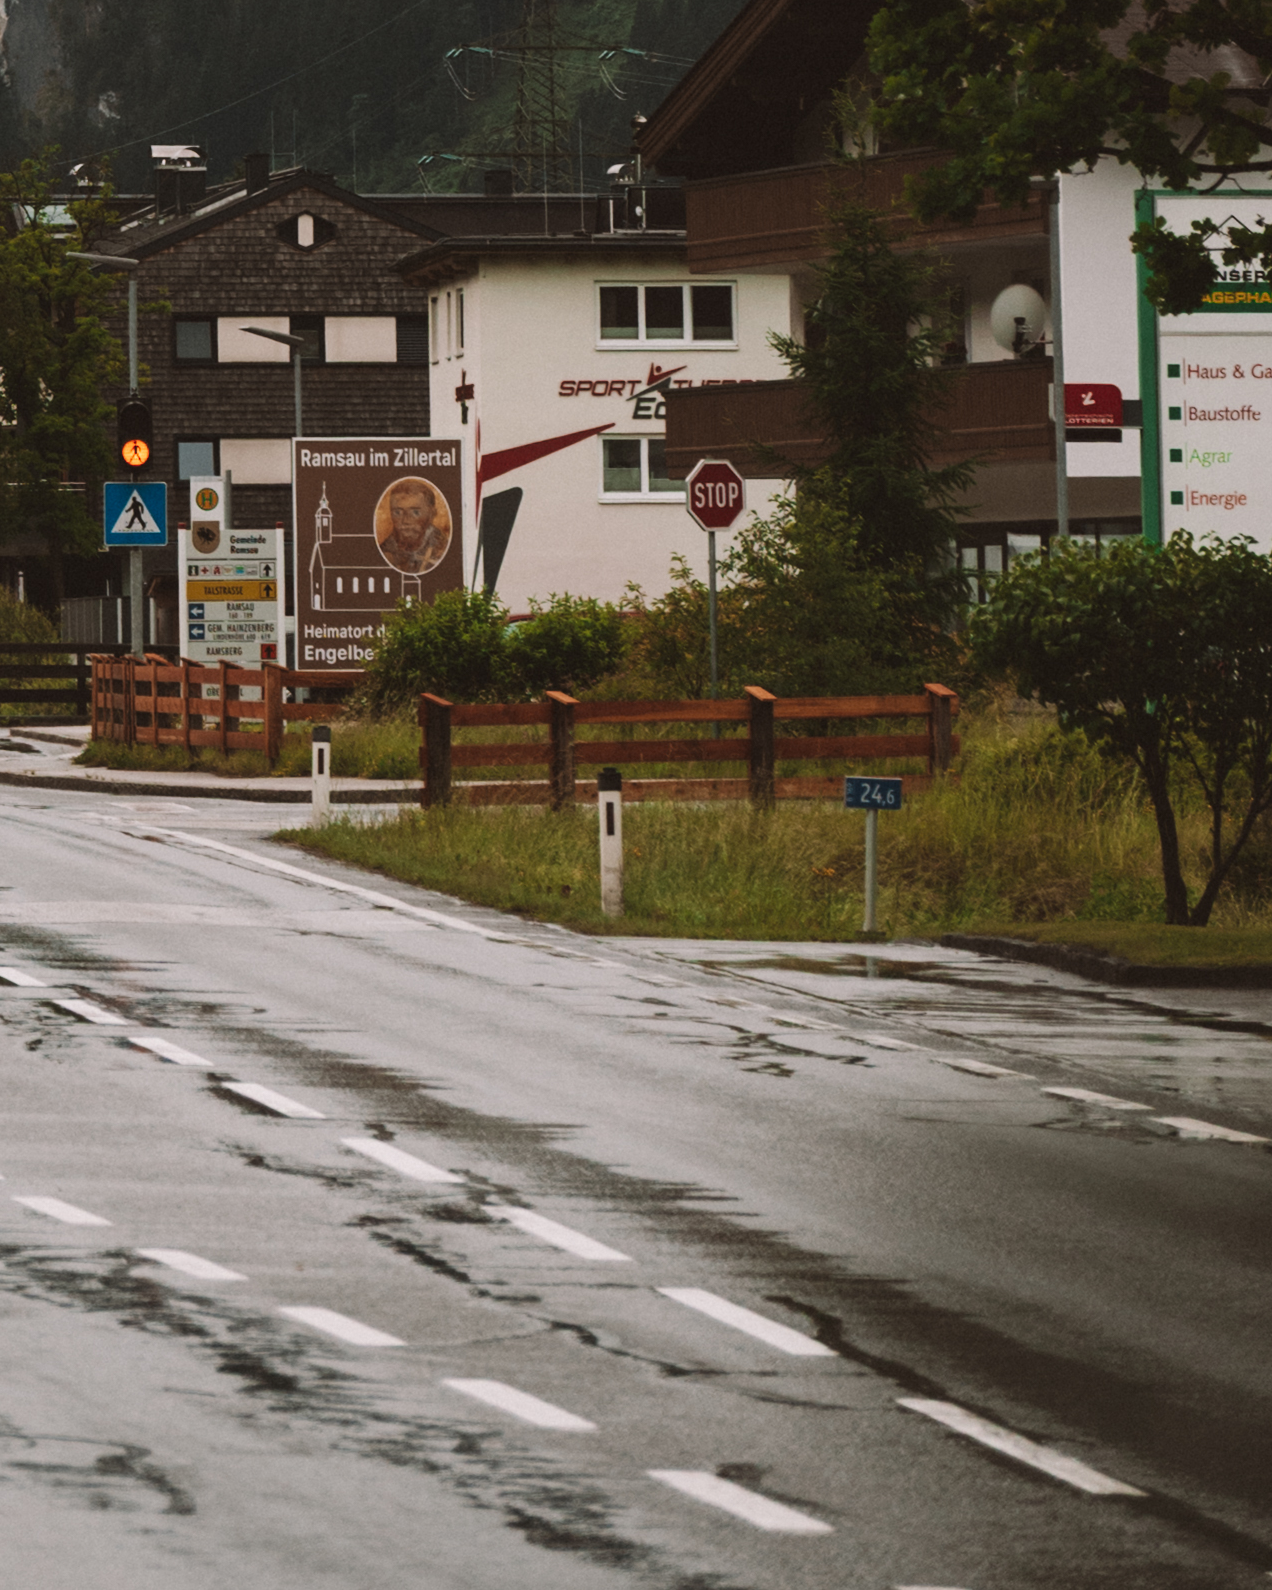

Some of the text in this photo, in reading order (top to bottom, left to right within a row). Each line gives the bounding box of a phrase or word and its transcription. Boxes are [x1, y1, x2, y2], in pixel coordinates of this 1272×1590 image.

[1187, 364, 1227, 379] Haus
[1232, 364, 1245, 379] &
[559, 380, 642, 396] SPORT
[1188, 404, 1261, 421] Baustoffe
[300, 447, 456, 467] Ramsau im Zillertal
[1189, 448, 1233, 468] Agrar
[201, 492, 213, 506] H
[695, 482, 739, 508] STOP
[1190, 490, 1247, 510] Energie
[204, 586, 243, 595] TALSTRASSE
[226, 603, 255, 611] RAMSAU
[207, 623, 275, 633] GEM. HAINZENBERG
[304, 624, 373, 639] Heimatort
[206, 647, 243, 656] RAMSBERG
[860, 782, 895, 807] 24,6
